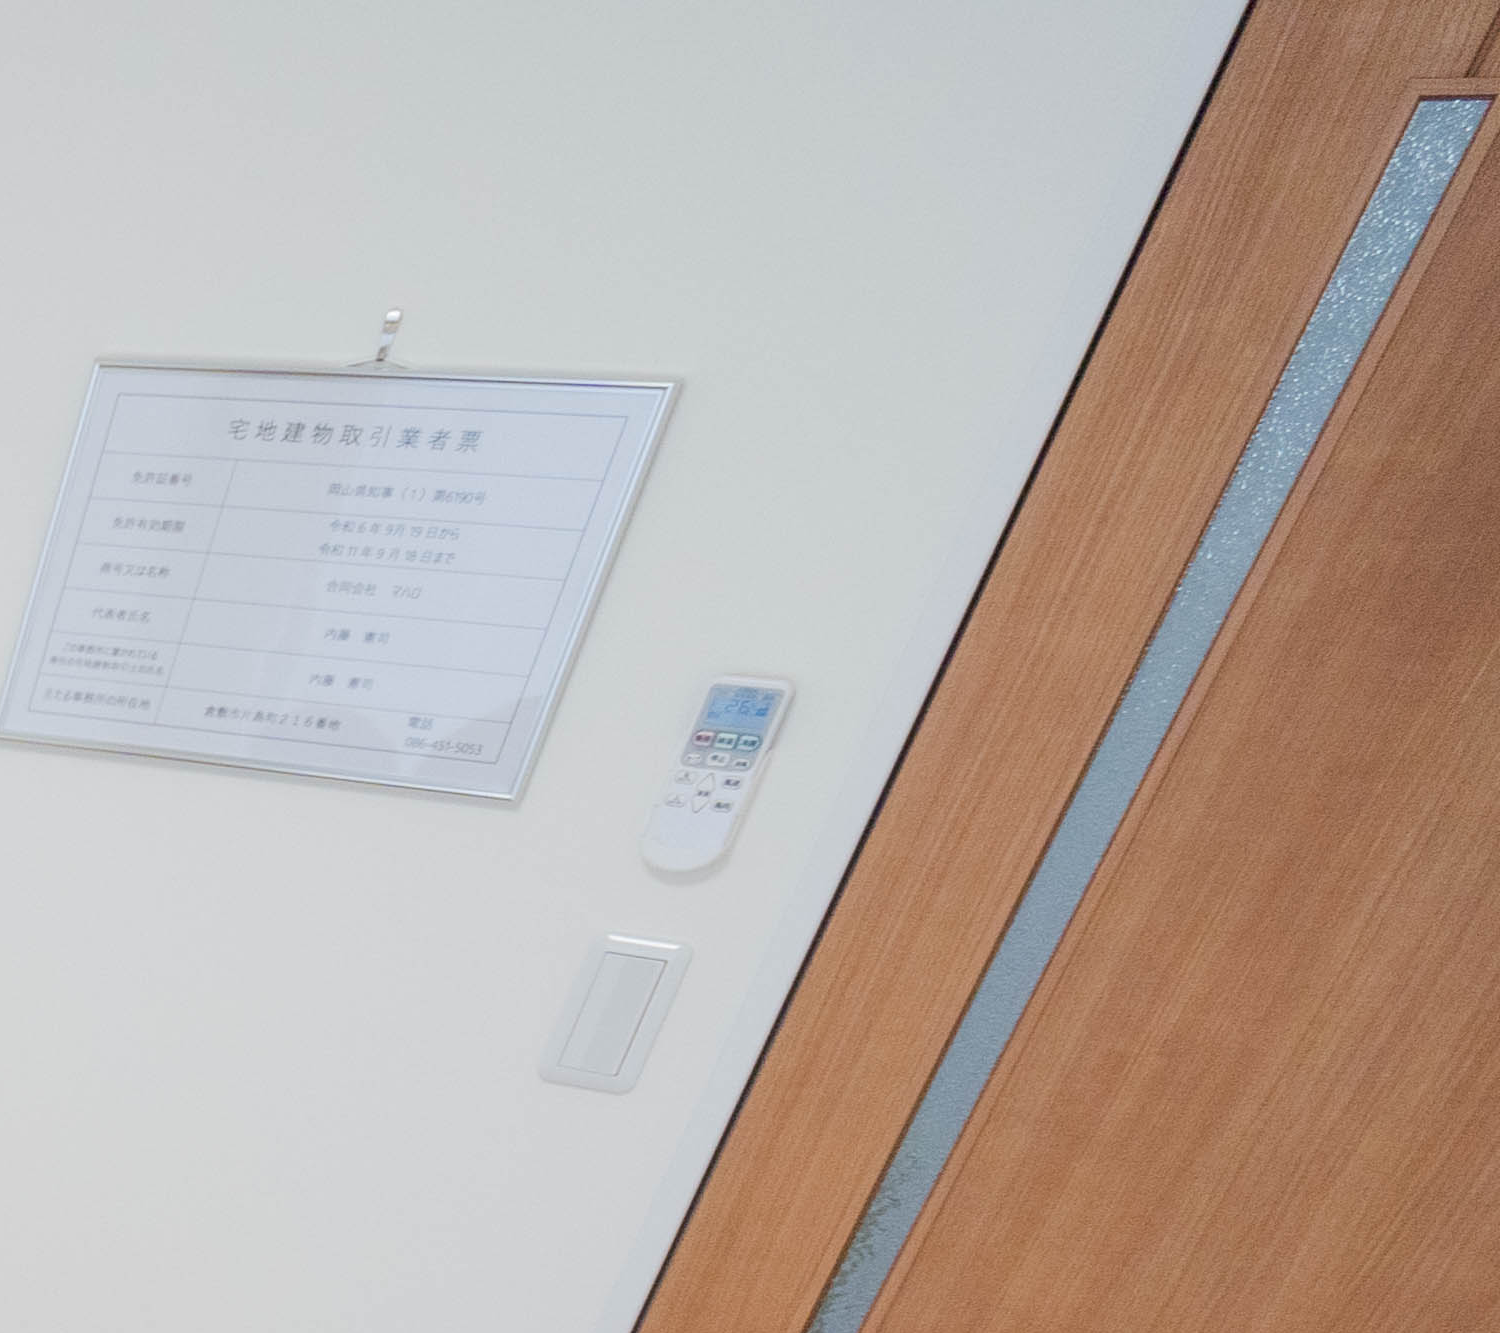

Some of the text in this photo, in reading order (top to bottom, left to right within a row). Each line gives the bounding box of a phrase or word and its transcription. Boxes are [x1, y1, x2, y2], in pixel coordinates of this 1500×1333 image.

[227, 417, 483, 454] 宅地建物取引業者票
